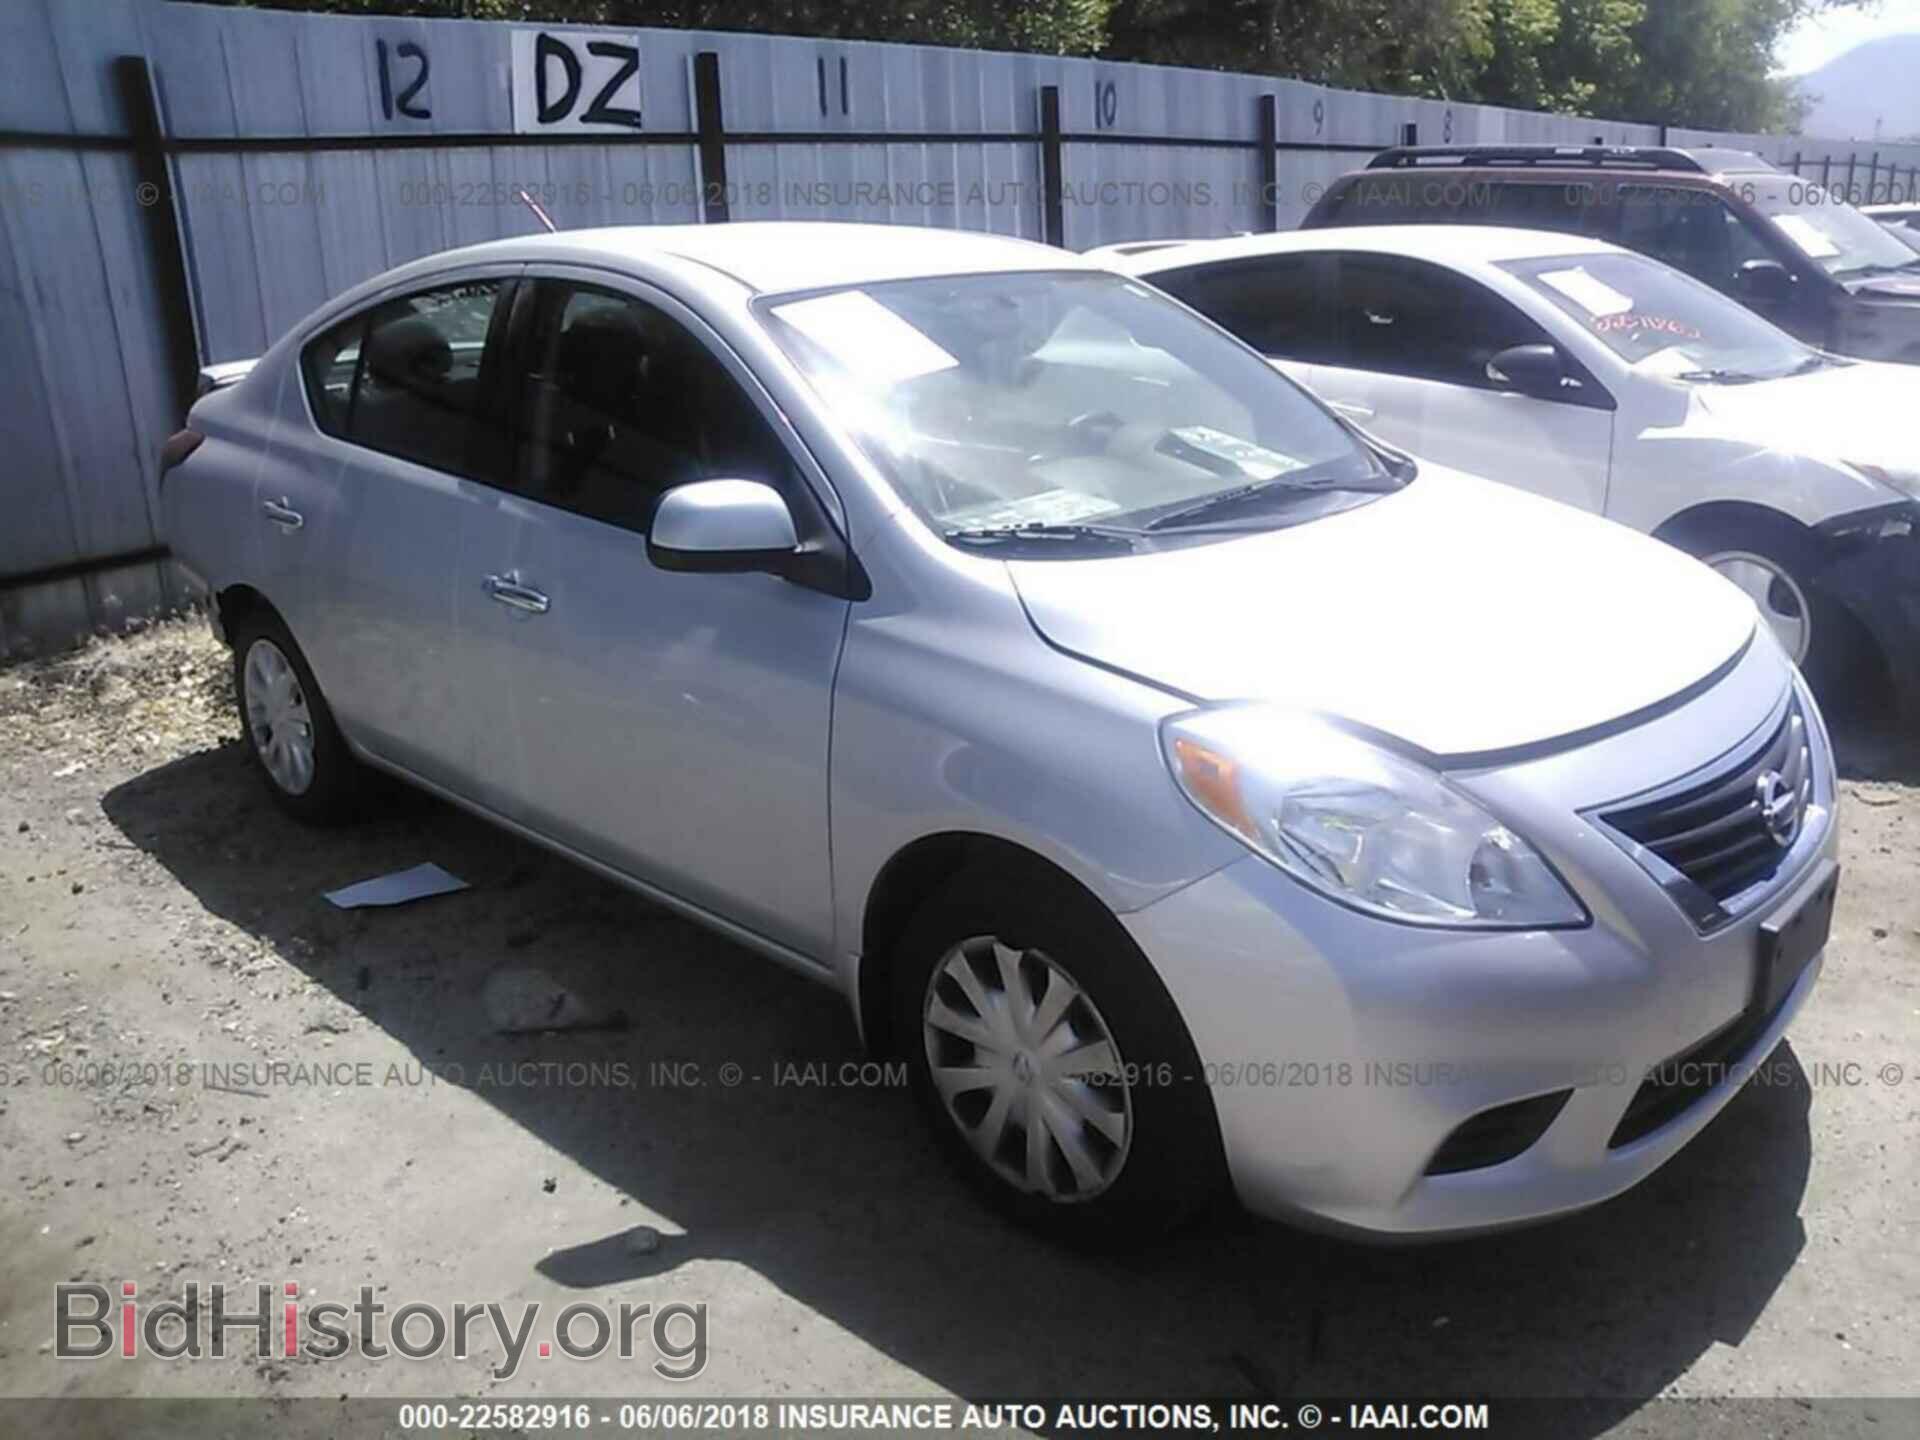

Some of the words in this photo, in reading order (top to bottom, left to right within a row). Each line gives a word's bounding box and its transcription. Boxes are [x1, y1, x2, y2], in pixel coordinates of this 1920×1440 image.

[376, 37, 432, 121] 12
[535, 33, 642, 129] DZ
[817, 57, 848, 117] 11
[1095, 81, 1117, 129] 10
[1313, 99, 1324, 136] 9
